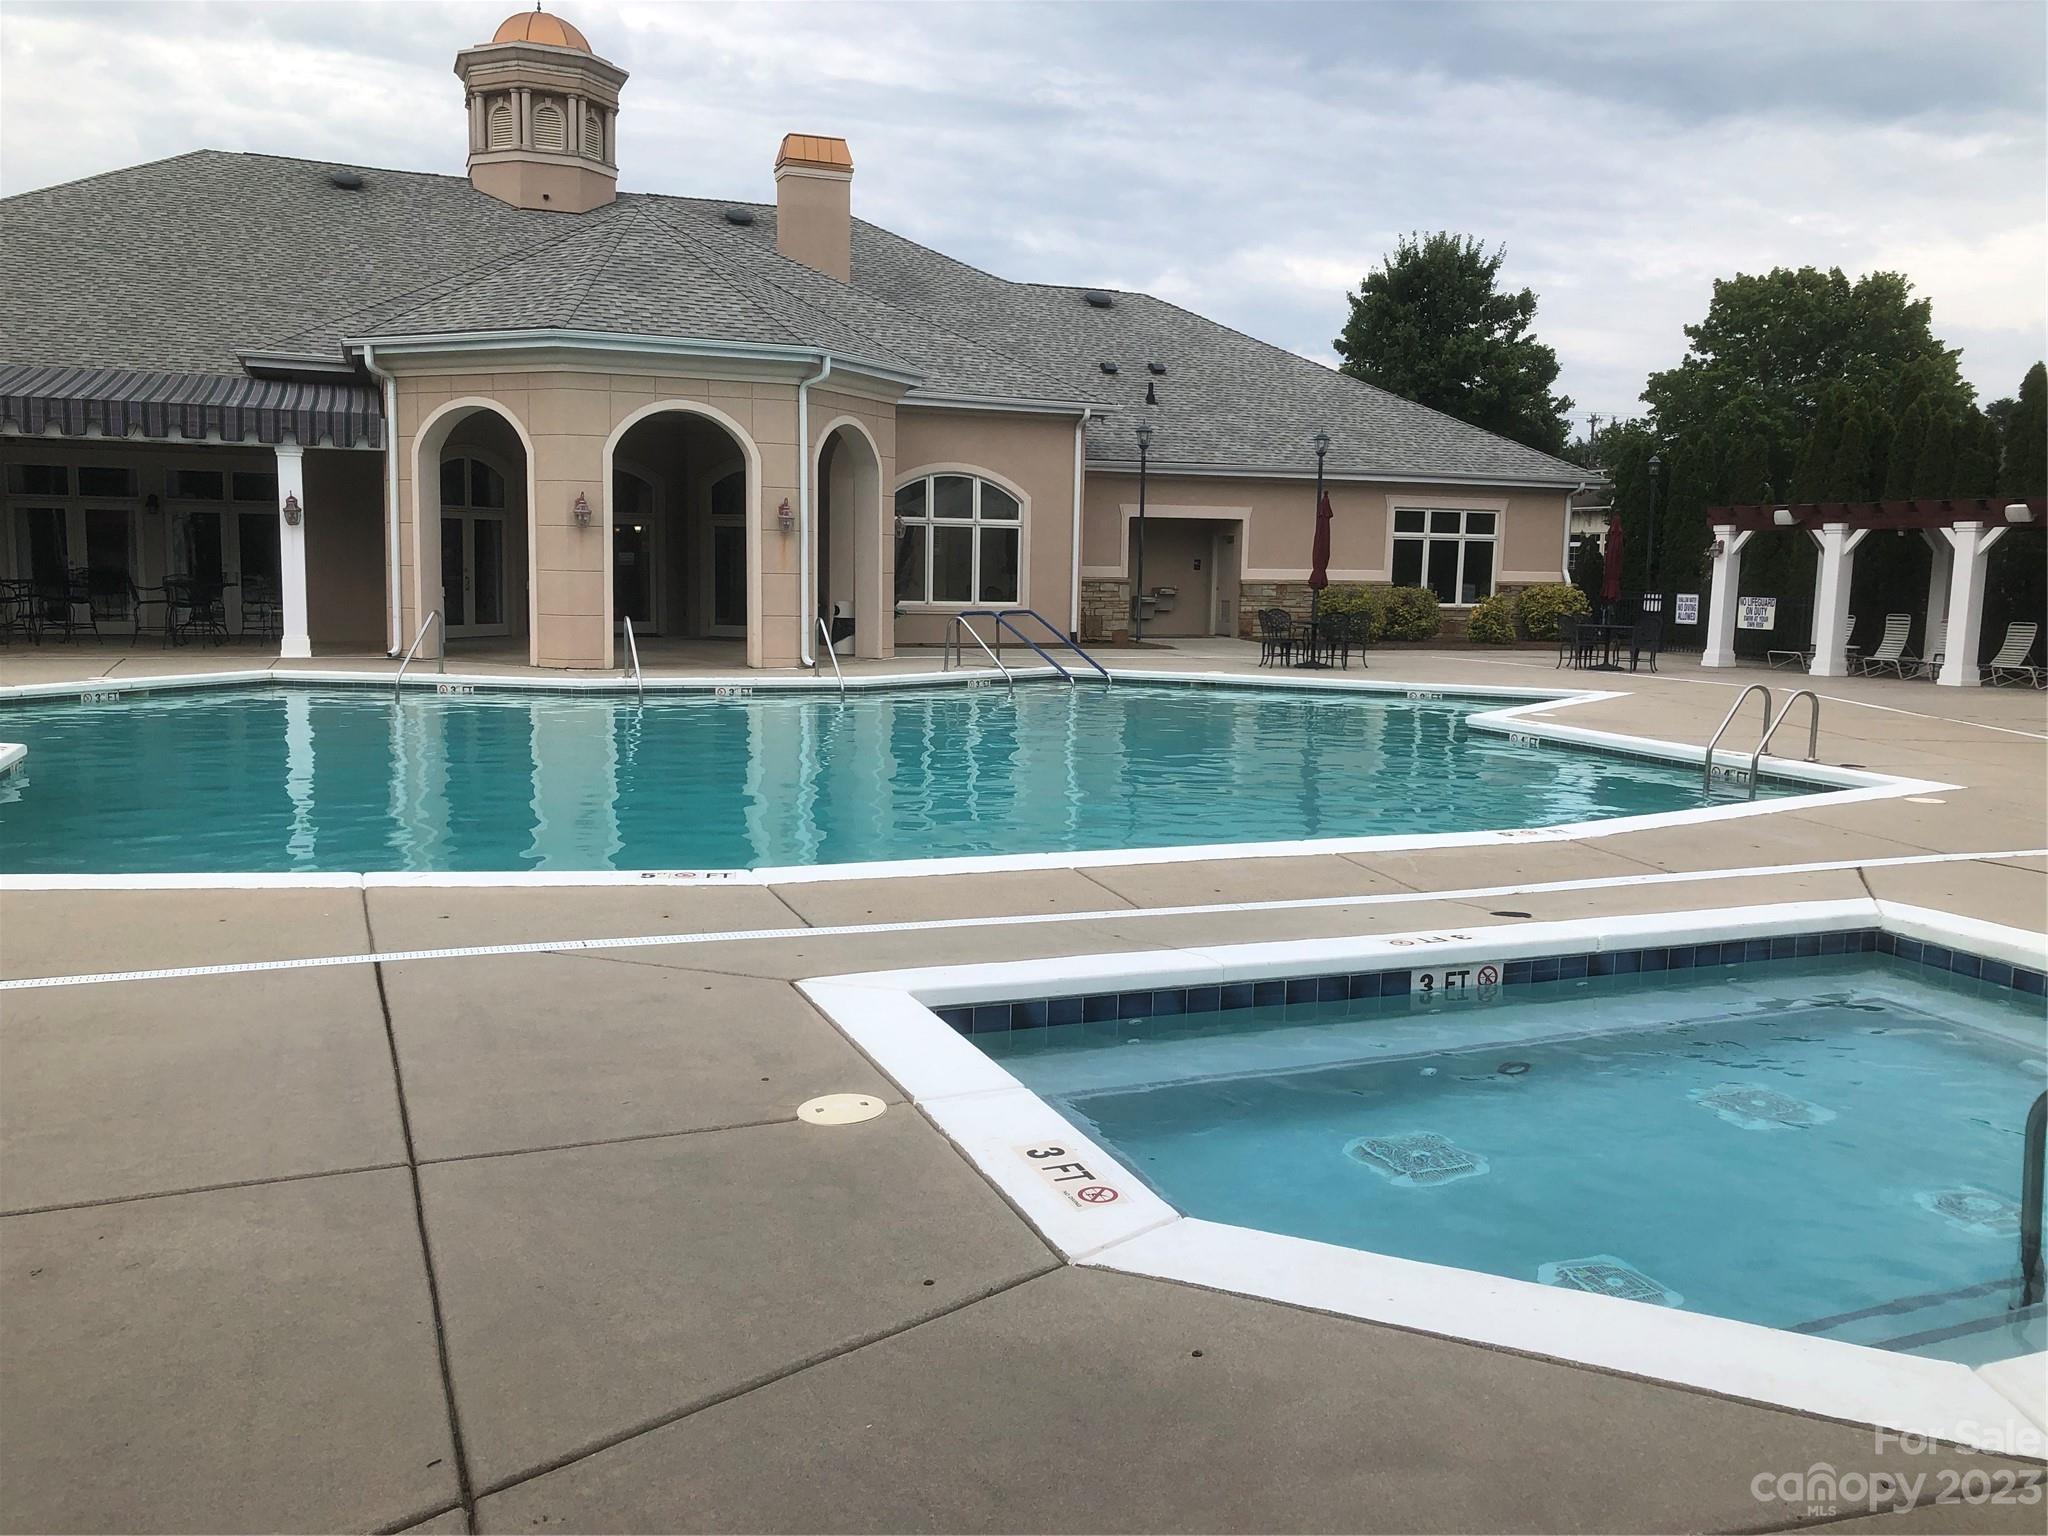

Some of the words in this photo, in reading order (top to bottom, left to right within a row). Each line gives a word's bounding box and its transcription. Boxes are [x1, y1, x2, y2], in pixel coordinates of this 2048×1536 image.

[1748, 598, 1775, 607] LIFEGUARD
[1746, 606, 1753, 616] ON
[1754, 607, 1767, 616] DUTY
[1420, 973, 1434, 991] 3
[1445, 970, 1470, 989] FT
[1026, 1147, 1066, 1159] 3
[1041, 1162, 1097, 1182] FT
